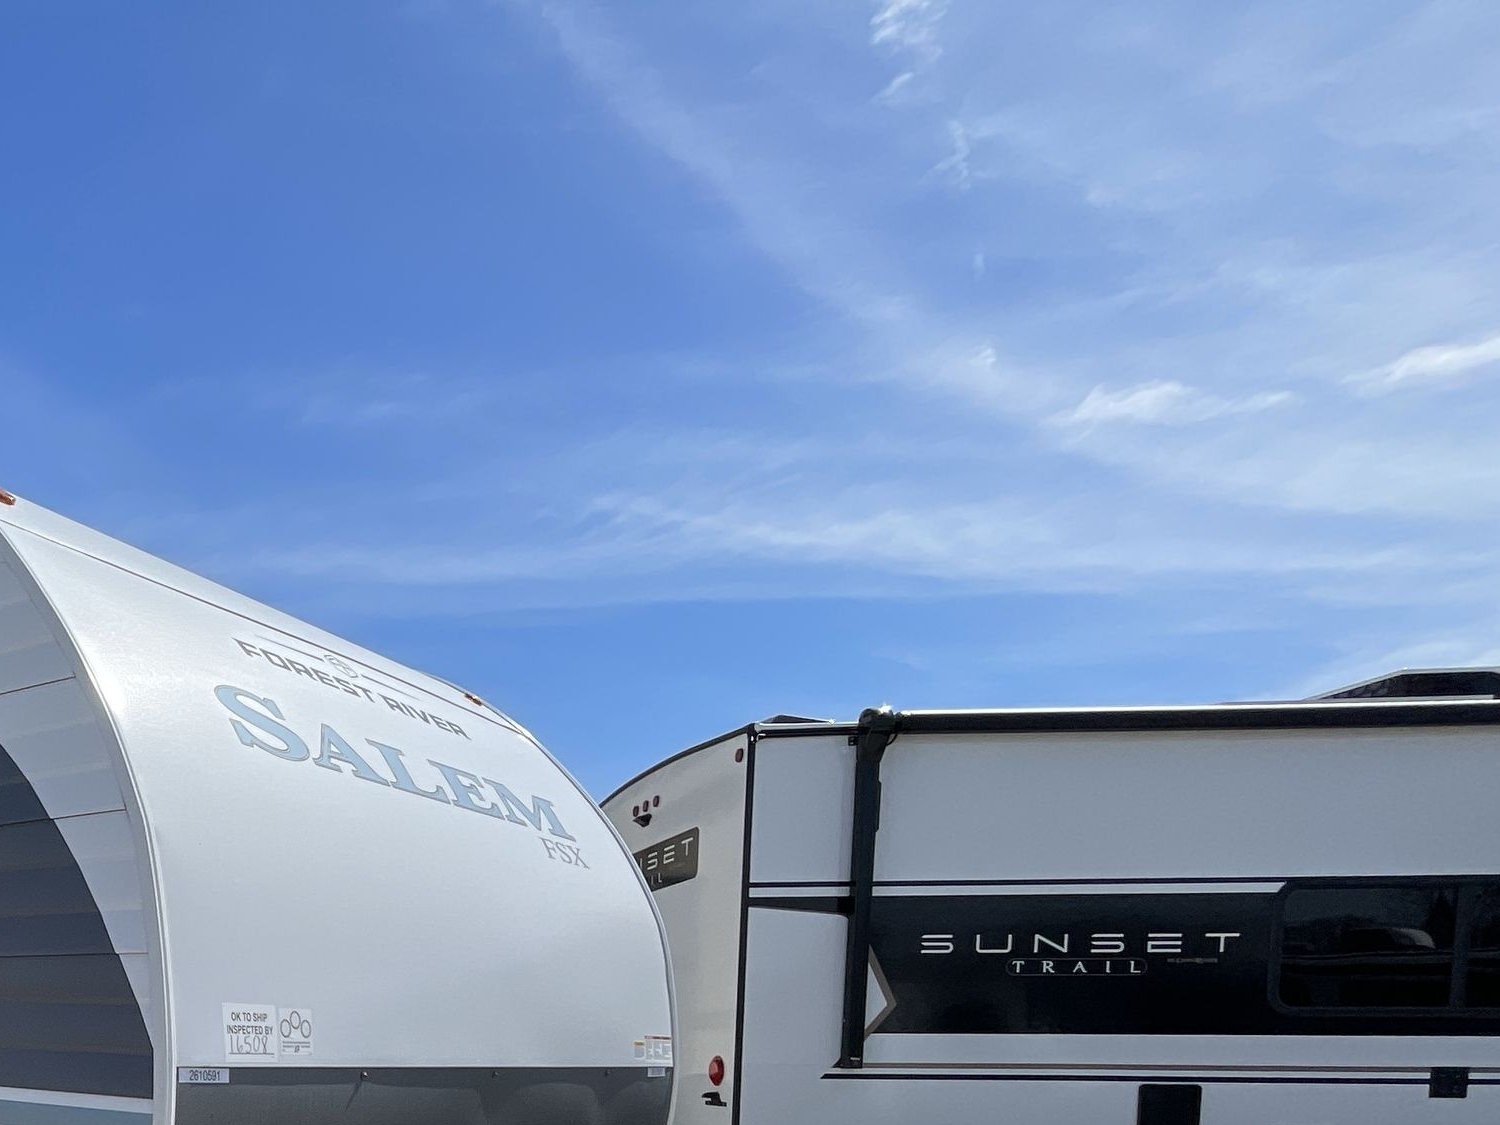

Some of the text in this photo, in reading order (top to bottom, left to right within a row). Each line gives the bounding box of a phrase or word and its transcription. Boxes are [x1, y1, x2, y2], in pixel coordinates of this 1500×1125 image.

[231, 637, 375, 703] FOREST
[380, 693, 472, 741] RIVER
[213, 684, 577, 842] SALEM
[538, 836, 591, 869] FSX
[640, 837, 694, 870] SET
[920, 933, 1241, 953] SUNSET
[1012, 960, 1141, 973] TRAIL
[226, 1025, 273, 1035] INSPECTED BY
[230, 1011, 268, 1023] OK TO SHIP
